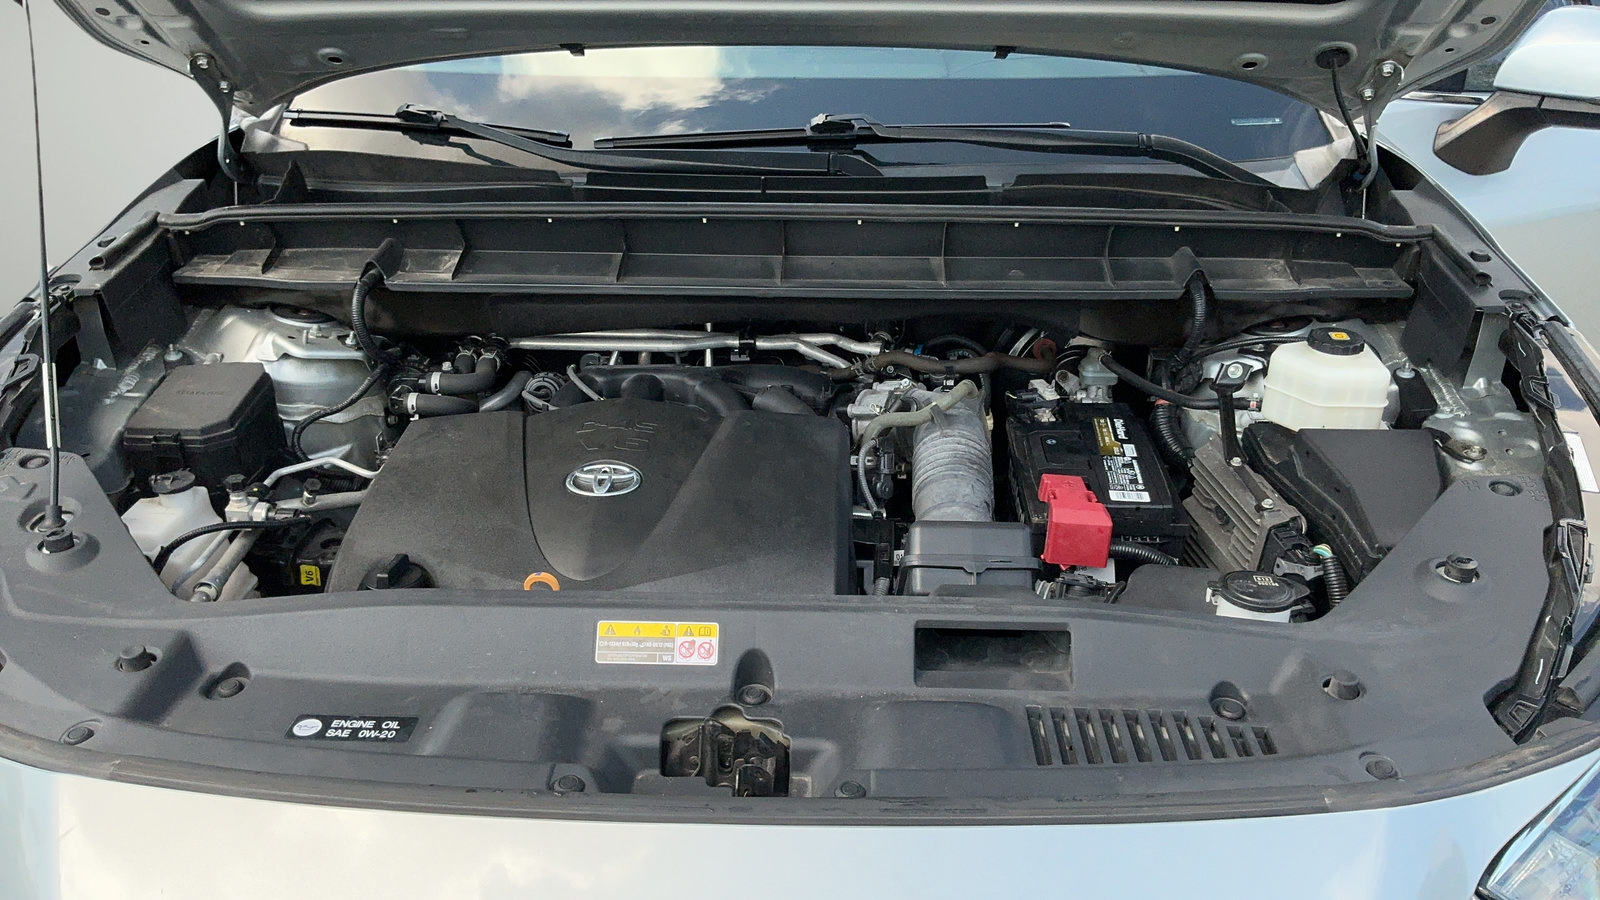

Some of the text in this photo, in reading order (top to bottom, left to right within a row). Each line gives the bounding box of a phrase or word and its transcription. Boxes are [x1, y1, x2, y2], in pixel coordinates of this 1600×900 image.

[304, 570, 314, 582] V6
[330, 719, 401, 729] ENGINE OIL
[325, 729, 396, 739] SAE 0W-20
